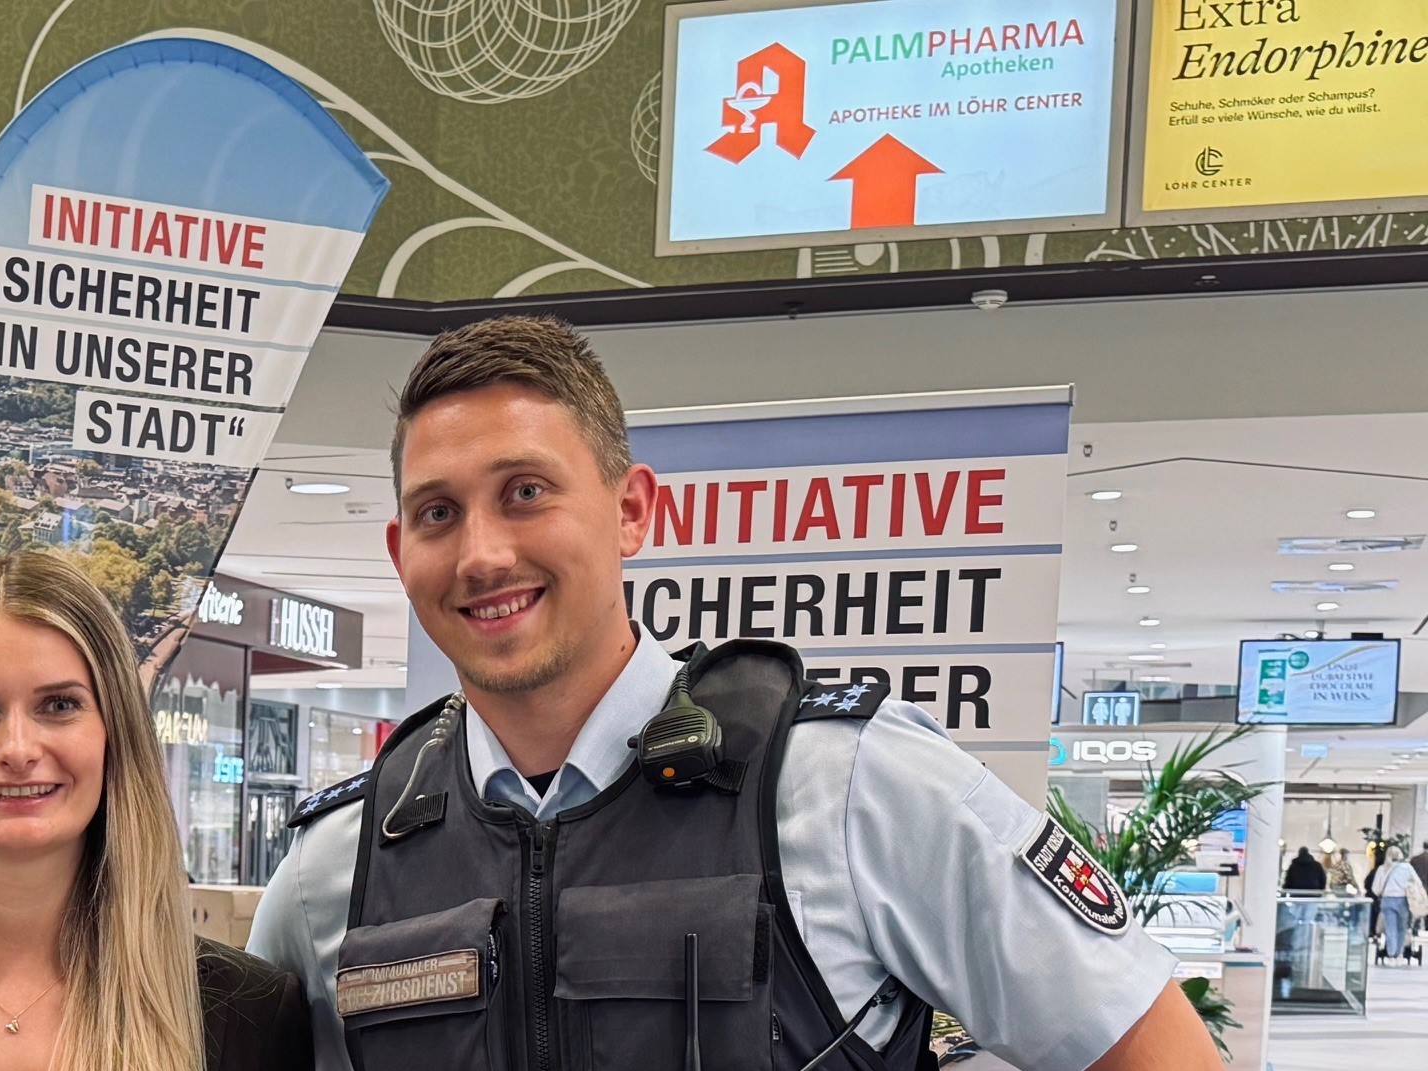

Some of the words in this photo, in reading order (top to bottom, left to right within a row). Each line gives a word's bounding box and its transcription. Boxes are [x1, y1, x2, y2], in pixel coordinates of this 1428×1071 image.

[1174, 0, 1301, 32] Extra
[831, 19, 1085, 65] PALMPHARMA
[1172, 29, 1428, 81] Endorphine
[941, 54, 1054, 81] Apotheken
[829, 104, 922, 124] APOTHEKE
[928, 102, 950, 118] IM
[957, 95, 1007, 116] LÖHR
[1014, 92, 1083, 112] CENTER
[1169, 113, 1199, 126] Erfüll
[1201, 116, 1215, 124] so
[1218, 112, 1244, 123] viele
[1247, 108, 1303, 121] Wünsche,
[1306, 107, 1326, 118] wie
[1329, 105, 1344, 116] du
[1347, 102, 1381, 114] willst.
[1170, 101, 1215, 112] Schuhe,
[1218, 95, 1275, 109] Schmöker
[1278, 94, 1304, 105] oder
[1308, 88, 1376, 103] Schampus?
[1202, 178, 1252, 189] CENTER
[42, 194, 267, 270] INITIATIVE
[55, 330, 253, 397] UNSERER
[653, 468, 1006, 547] NITIATIVE
[622, 567, 1002, 643] ICHERHEIT
[280, 597, 338, 657] HUSSEL
[1073, 740, 1157, 763] IQOS
[1032, 843, 1056, 872] STADT
[1053, 874, 1118, 925] Kommunaler
[361, 958, 439, 981] KOMMUNALER
